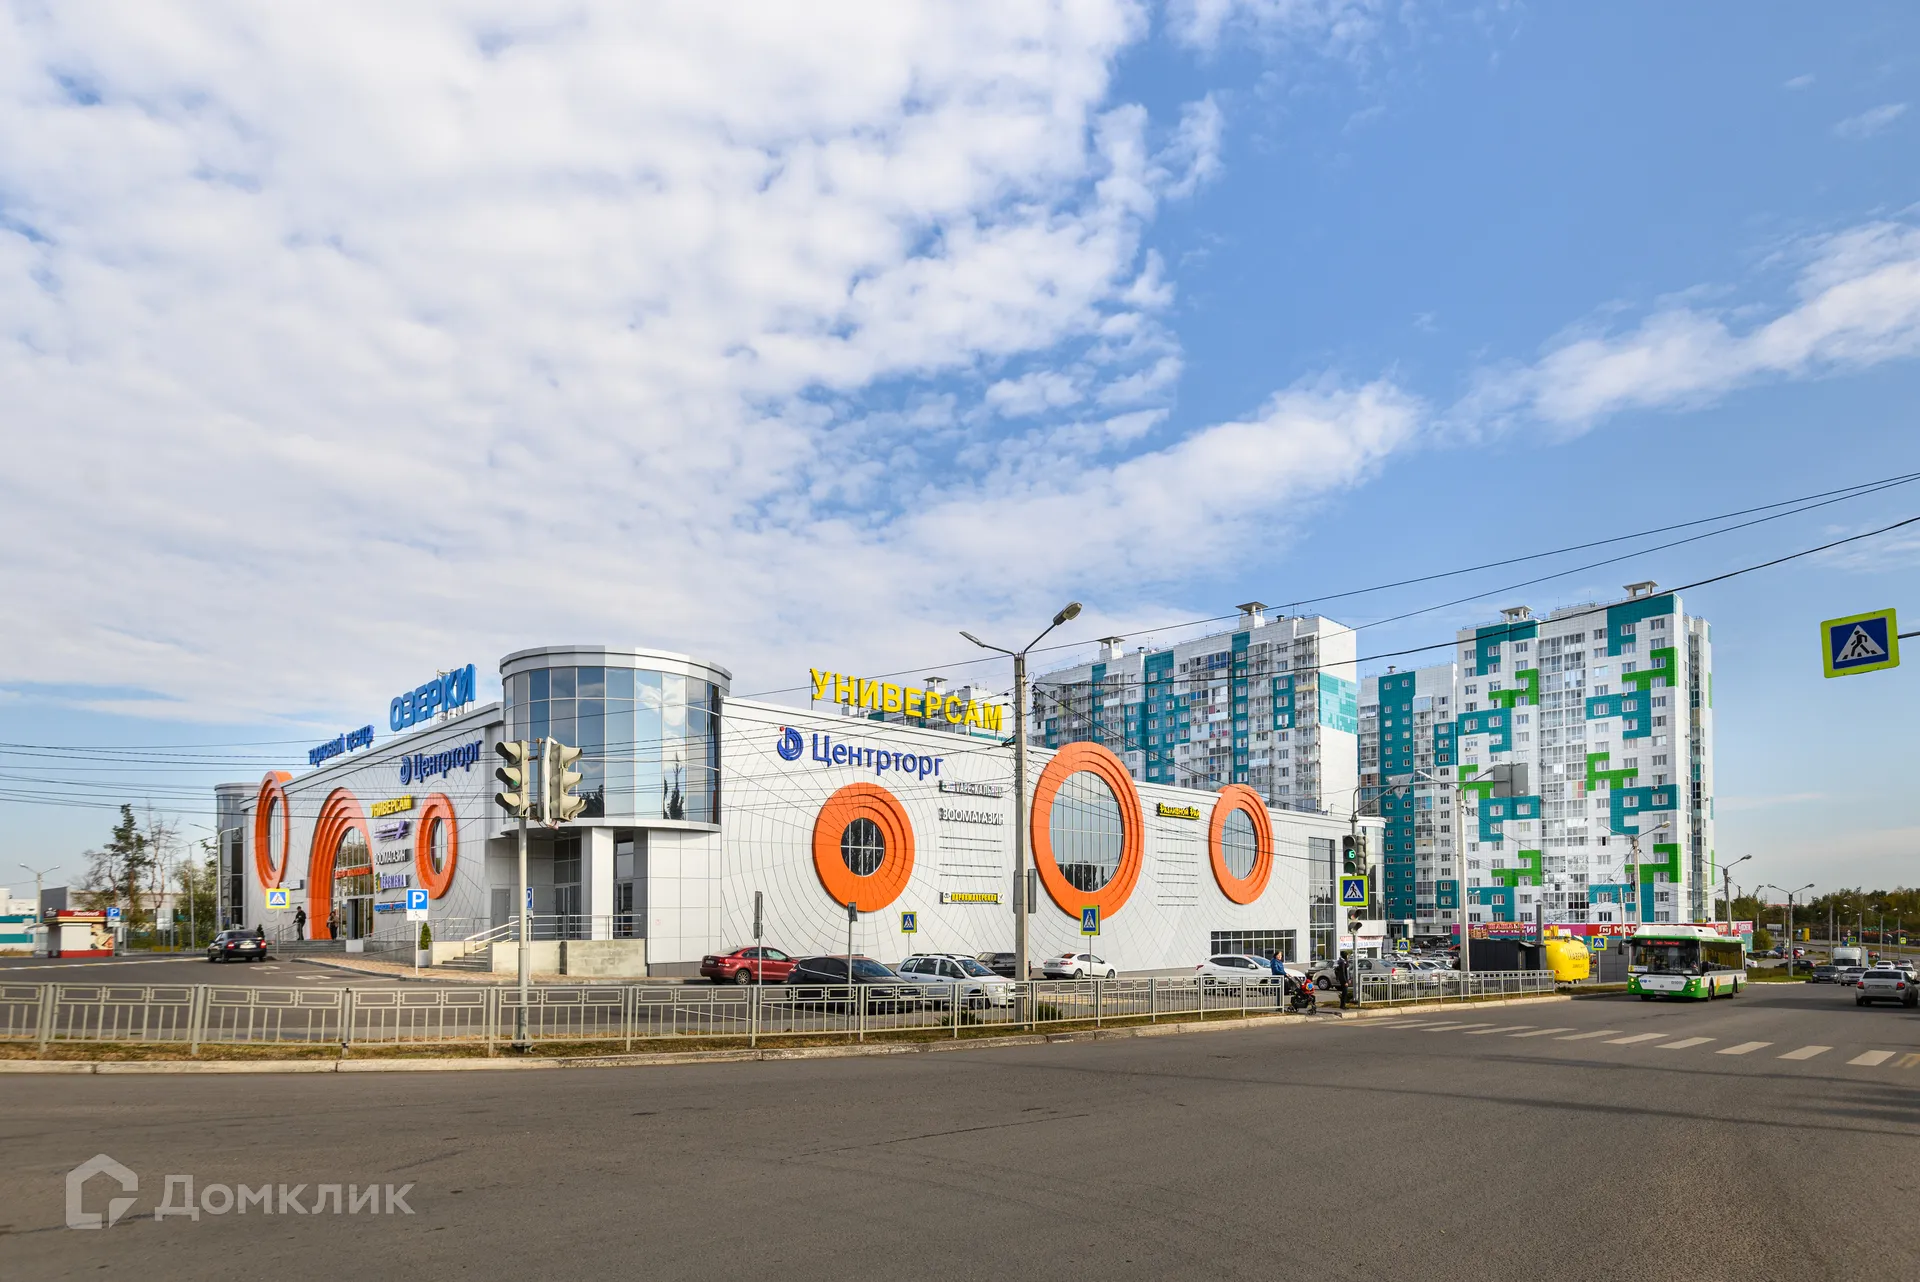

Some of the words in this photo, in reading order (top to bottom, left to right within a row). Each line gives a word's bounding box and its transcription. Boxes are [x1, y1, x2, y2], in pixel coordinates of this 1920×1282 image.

[390, 664, 476, 732] ОЗЕРКИ
[810, 668, 1002, 731] УНИВЕРСАМ
[414, 740, 483, 783] Центрторг
[812, 733, 944, 781] Центрторг
[371, 795, 412, 818] УНИВЕРСАМ
[942, 808, 1004, 825] ЗООМАГАЗИН
